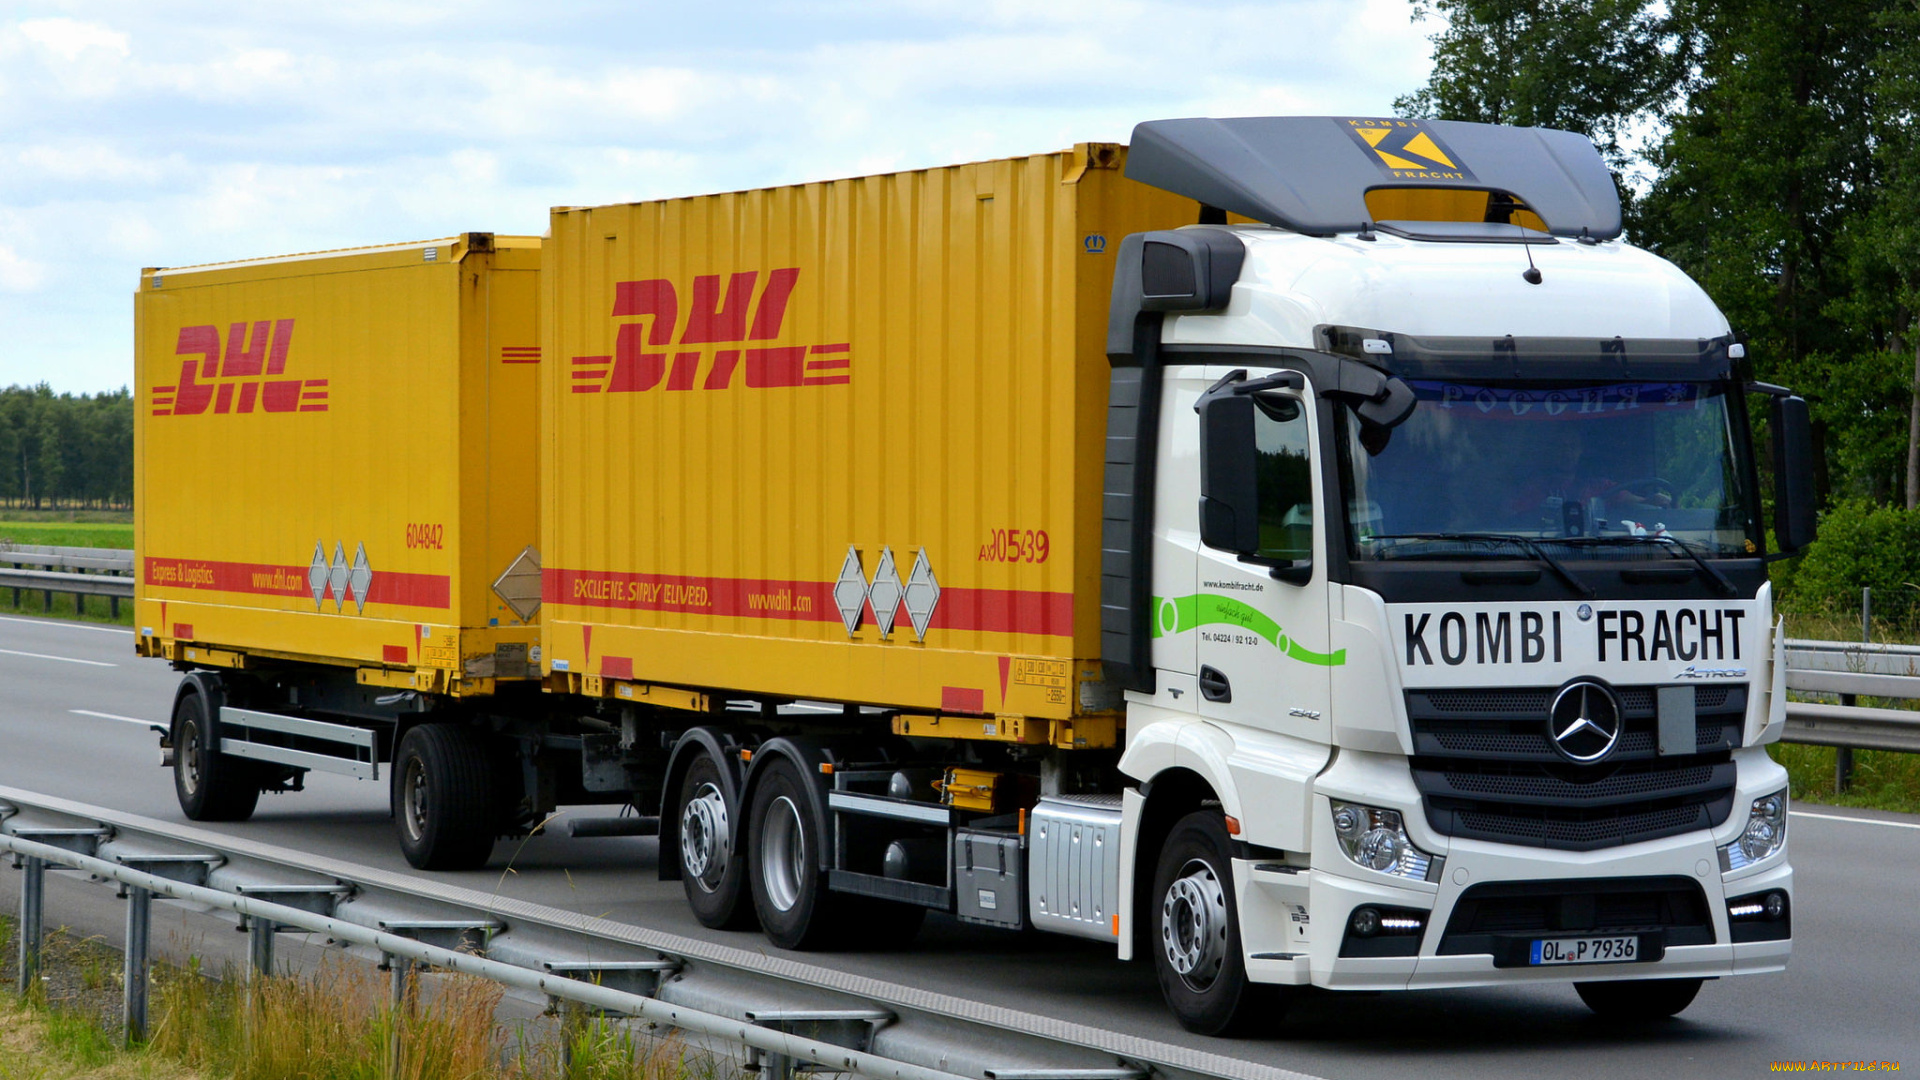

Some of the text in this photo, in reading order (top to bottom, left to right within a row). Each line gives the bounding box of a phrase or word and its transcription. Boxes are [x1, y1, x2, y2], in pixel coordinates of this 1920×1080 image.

[1347, 119, 1419, 128] KOMBI
[1392, 171, 1464, 180] FRACHT
[606, 267, 807, 393] DHL
[173, 318, 303, 416] DHL
[1440, 384, 1644, 416] РОССИЯ
[406, 523, 443, 550] 604842
[152, 561, 177, 585] Express
[178, 562, 184, 582] &
[252, 568, 303, 591] www.dhl.com
[1203, 579, 1264, 592] www.kombifracht.de
[1240, 612, 1254, 626] gut
[1202, 632, 1212, 641] Tel.
[1213, 633, 1231, 643] 04224
[1235, 635, 1243, 644] 92
[1245, 636, 1258, 646] 12-0
[1404, 608, 1746, 666] KOMBI FRACHT
[1543, 939, 1635, 961] OL P 7936
